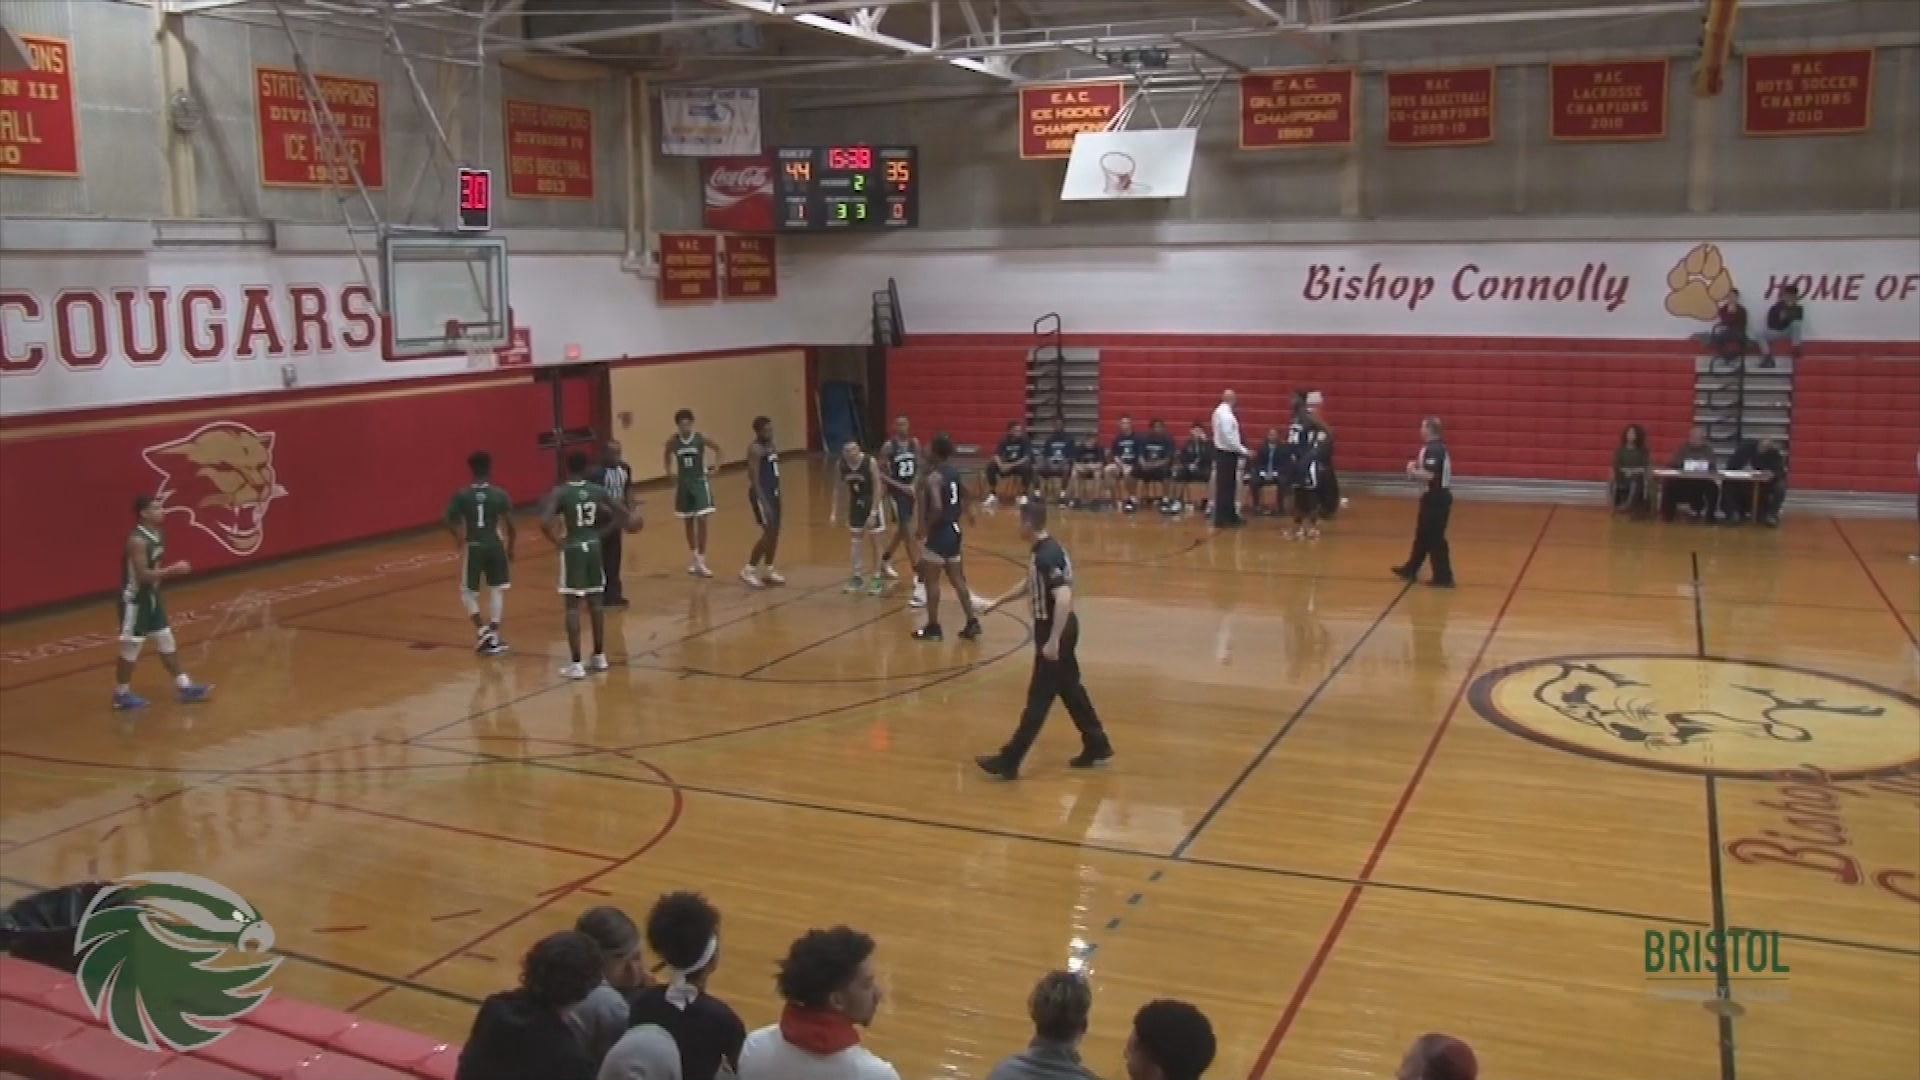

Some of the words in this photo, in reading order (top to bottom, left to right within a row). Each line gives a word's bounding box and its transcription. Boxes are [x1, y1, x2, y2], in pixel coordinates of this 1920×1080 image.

[261, 73, 305, 101] STATE
[1572, 85, 1643, 99] LACROSSE
[1801, 76, 1857, 89] SOCCER
[1566, 100, 1649, 115] CHAMPIONS
[1761, 92, 1852, 108] CHAMPIONS
[1031, 107, 1054, 120] ICE
[1055, 105, 1112, 119] HOCKEY
[1254, 110, 1338, 125] CHAMPIONS
[283, 133, 308, 162] ICE
[785, 161, 811, 181] 44
[886, 161, 909, 181] 35
[461, 175, 487, 209] 30
[853, 173, 864, 191] 2
[836, 202, 848, 219] 3
[856, 202, 866, 219] 3
[892, 203, 903, 219] 0
[1303, 261, 1434, 310] Bishop
[1452, 261, 1629, 312] Connolly
[1763, 273, 1866, 301] HOME
[1874, 273, 1920, 301] OF
[0, 284, 378, 374] COUGARS
[475, 503, 486, 527] 1
[575, 501, 597, 527] 13
